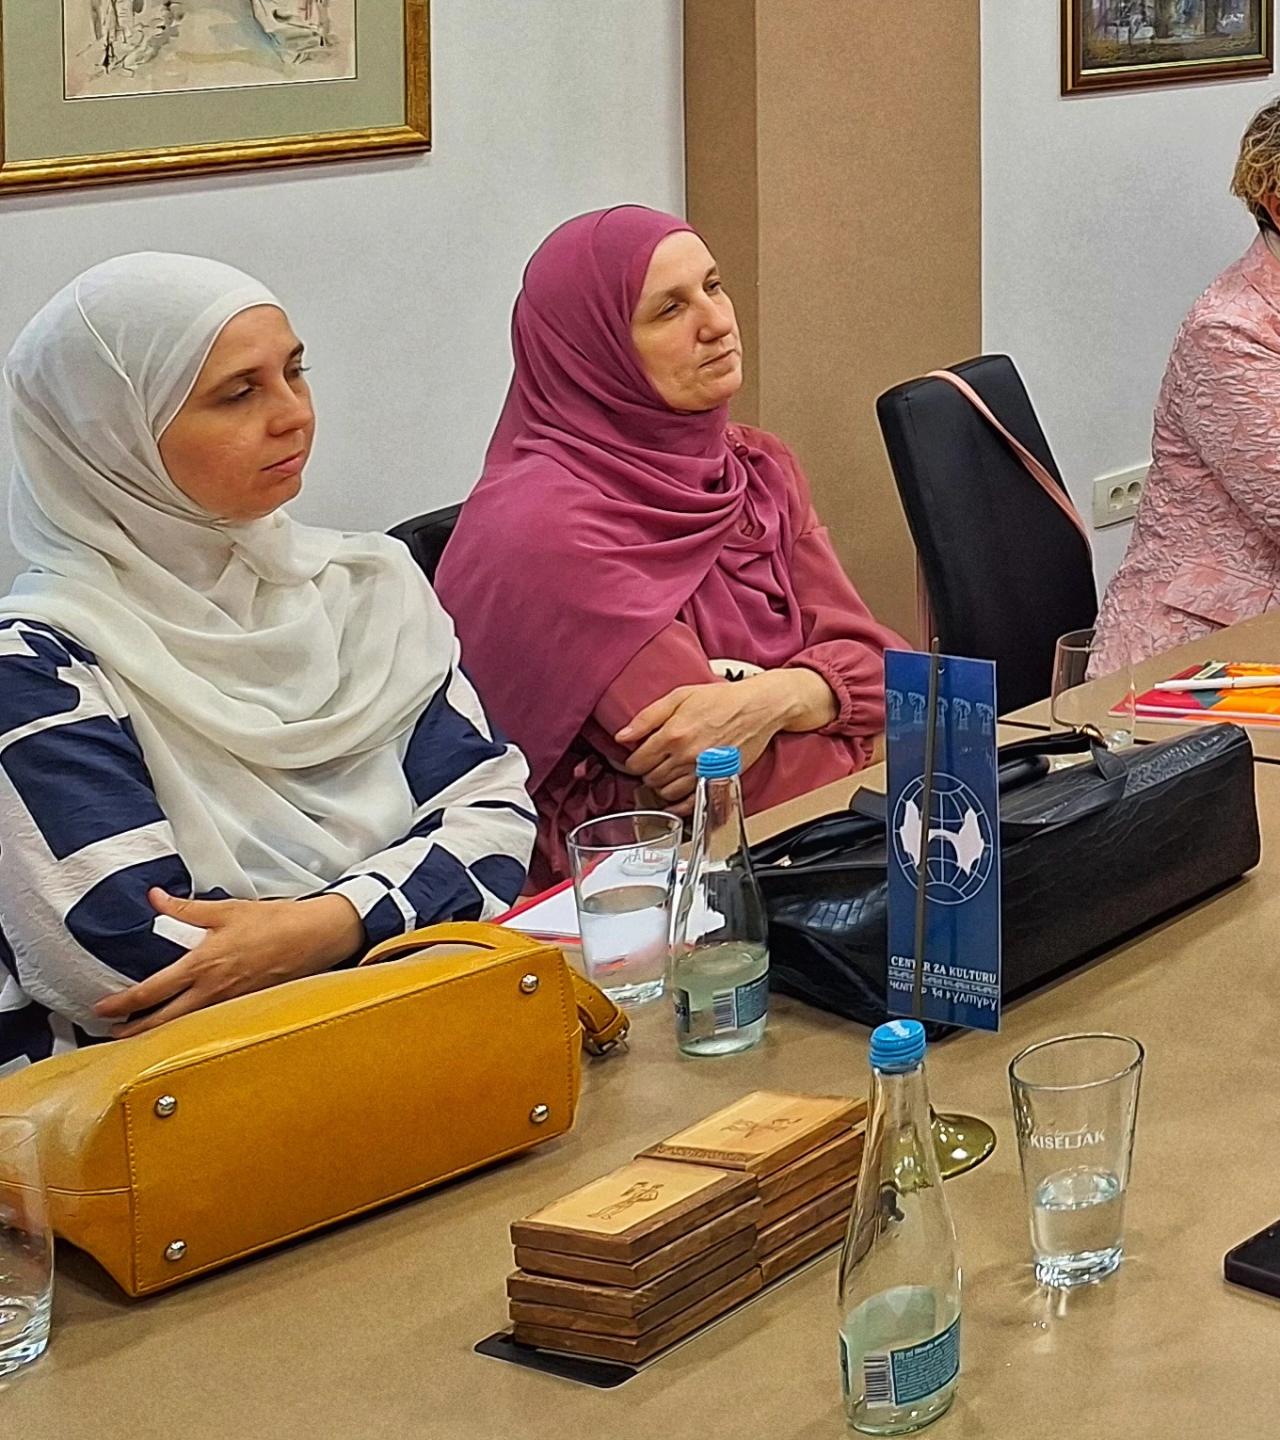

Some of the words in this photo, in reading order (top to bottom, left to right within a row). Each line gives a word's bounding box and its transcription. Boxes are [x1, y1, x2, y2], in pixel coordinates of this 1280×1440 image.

[890, 955, 932, 972] CENTR
[933, 962, 947, 975] ZA
[948, 965, 997, 984] KULTURU
[1030, 1128, 1106, 1150] KISELJAK
